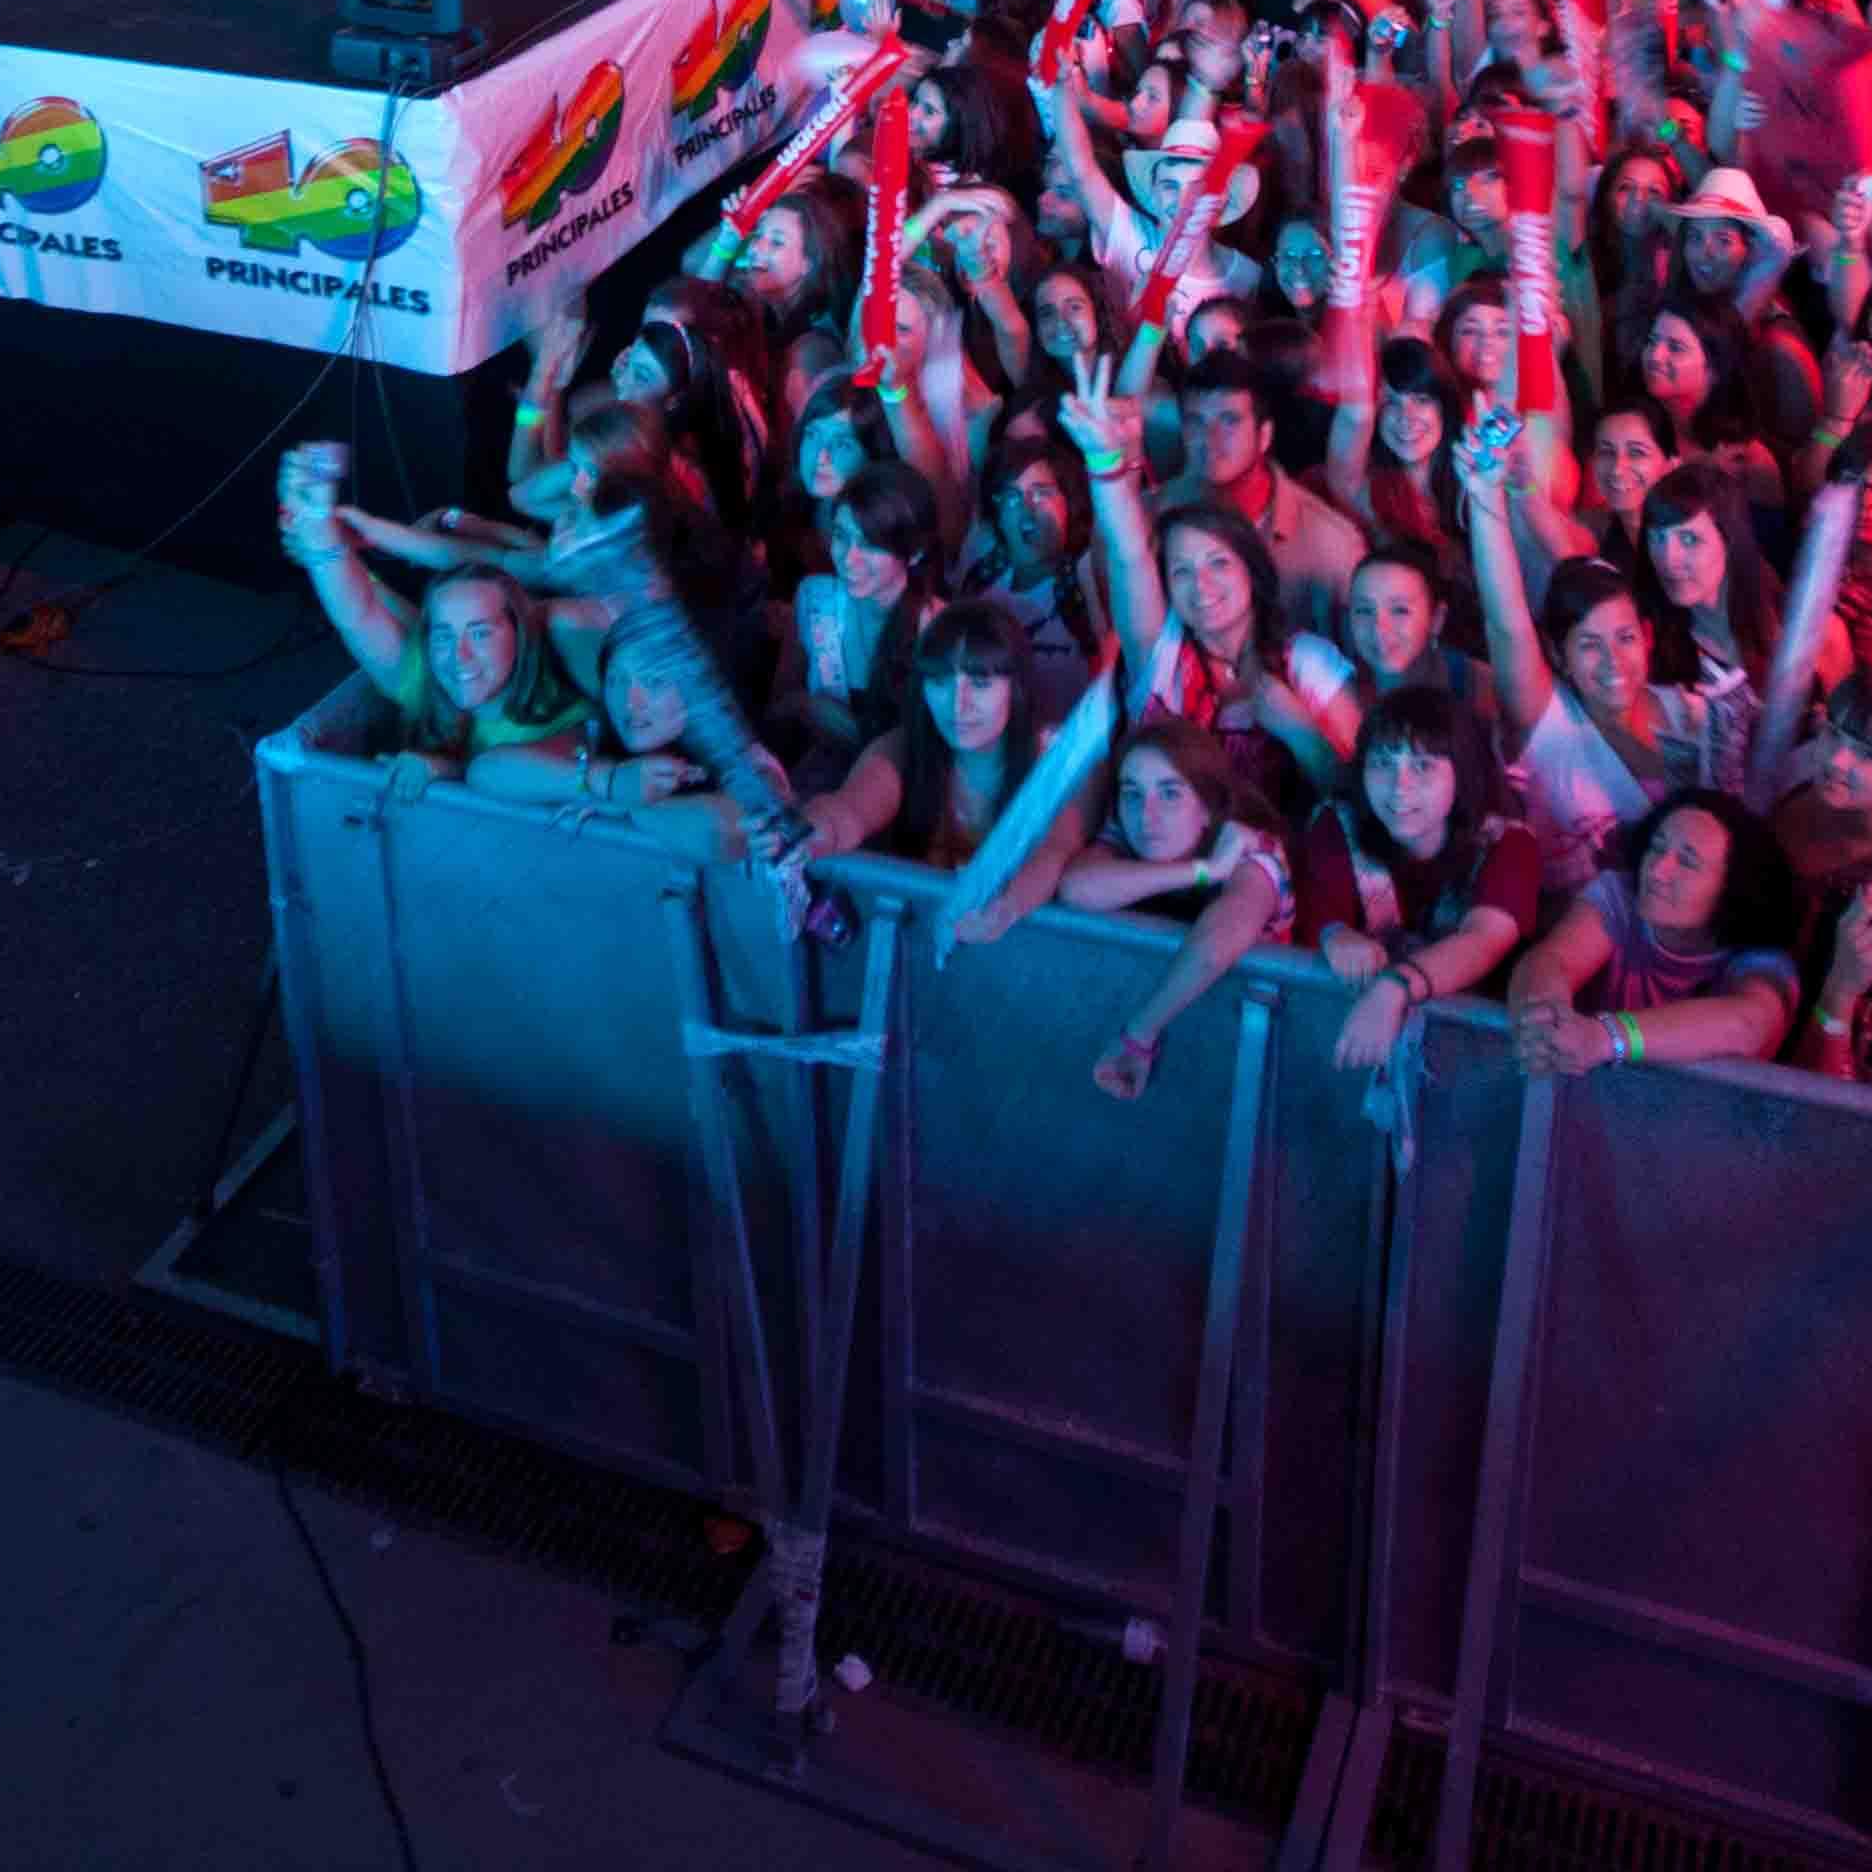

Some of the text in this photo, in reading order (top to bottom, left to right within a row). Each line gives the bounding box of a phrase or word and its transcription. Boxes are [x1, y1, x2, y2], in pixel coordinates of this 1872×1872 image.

[674, 84, 777, 169] PRINCIPALES
[506, 181, 635, 287] PRINCIPALES
[204, 255, 430, 315] PRINCIPALES
